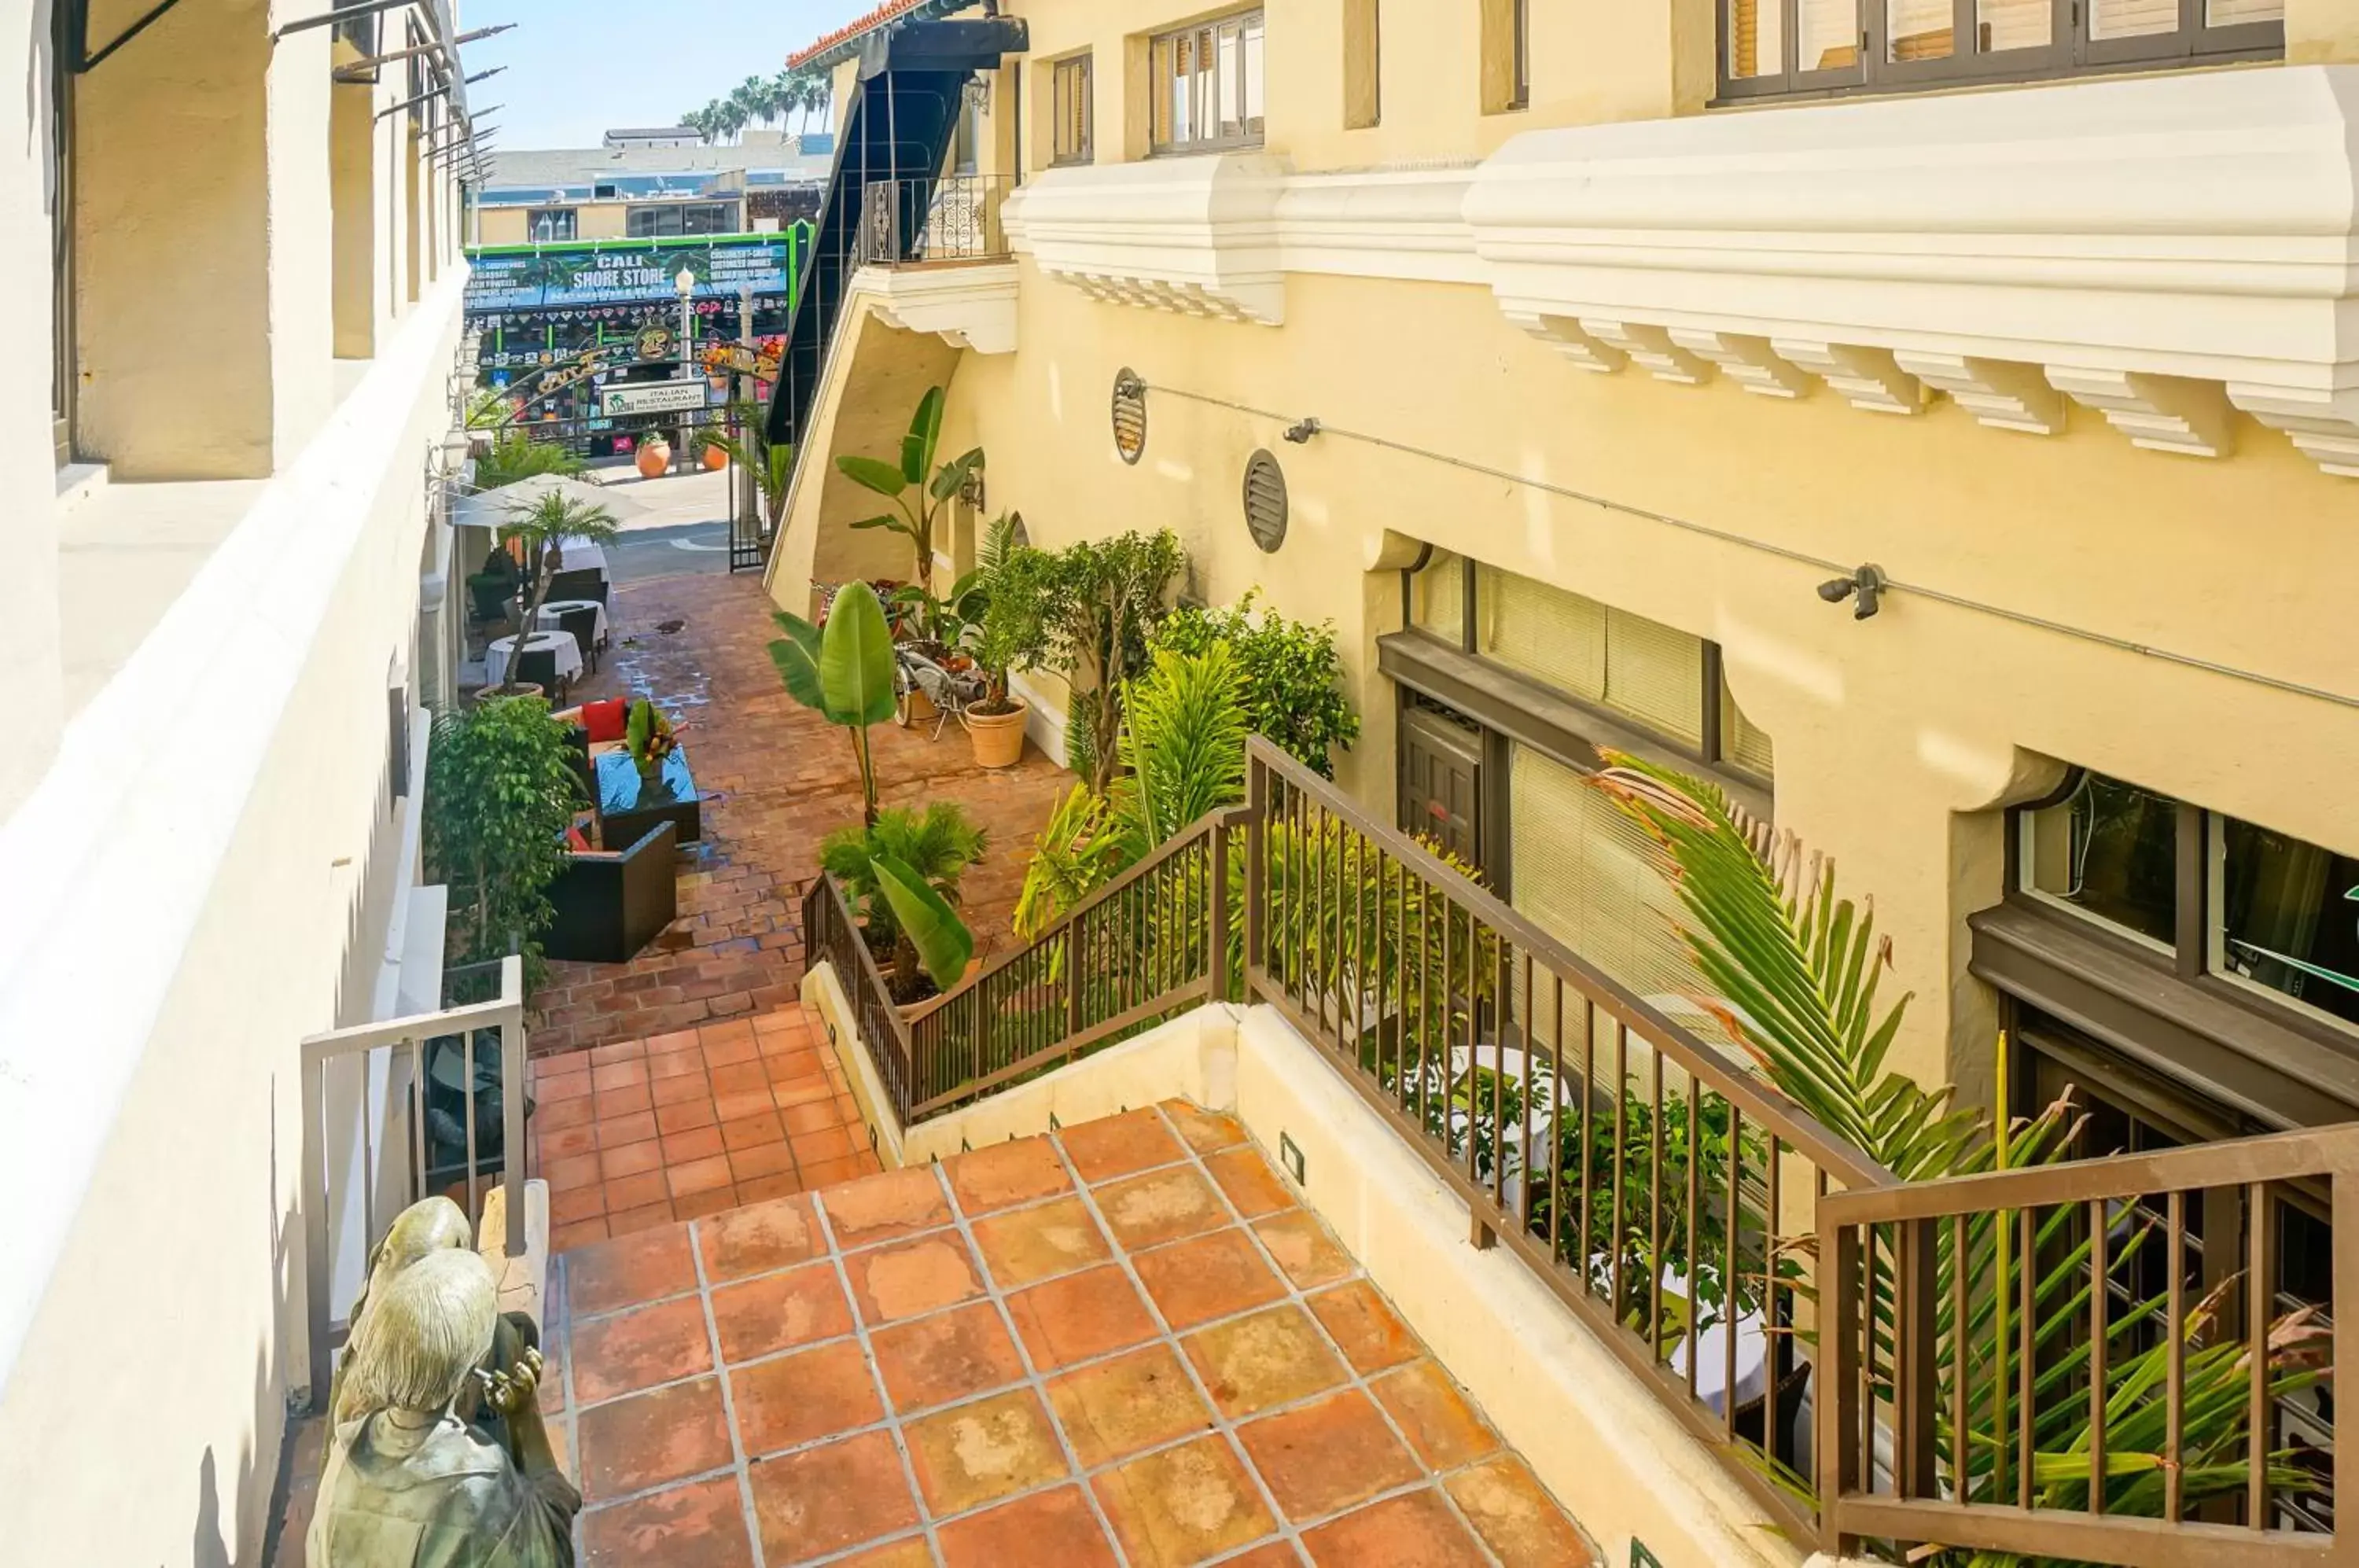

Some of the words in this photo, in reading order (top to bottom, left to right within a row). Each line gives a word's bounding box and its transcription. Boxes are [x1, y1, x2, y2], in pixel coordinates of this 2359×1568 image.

[597, 255, 642, 269] CALI
[573, 270, 620, 289] SHORE
[623, 267, 667, 286] STORE
[636, 394, 702, 405] RESTAURANT
[650, 389, 689, 398] ITALIAN
